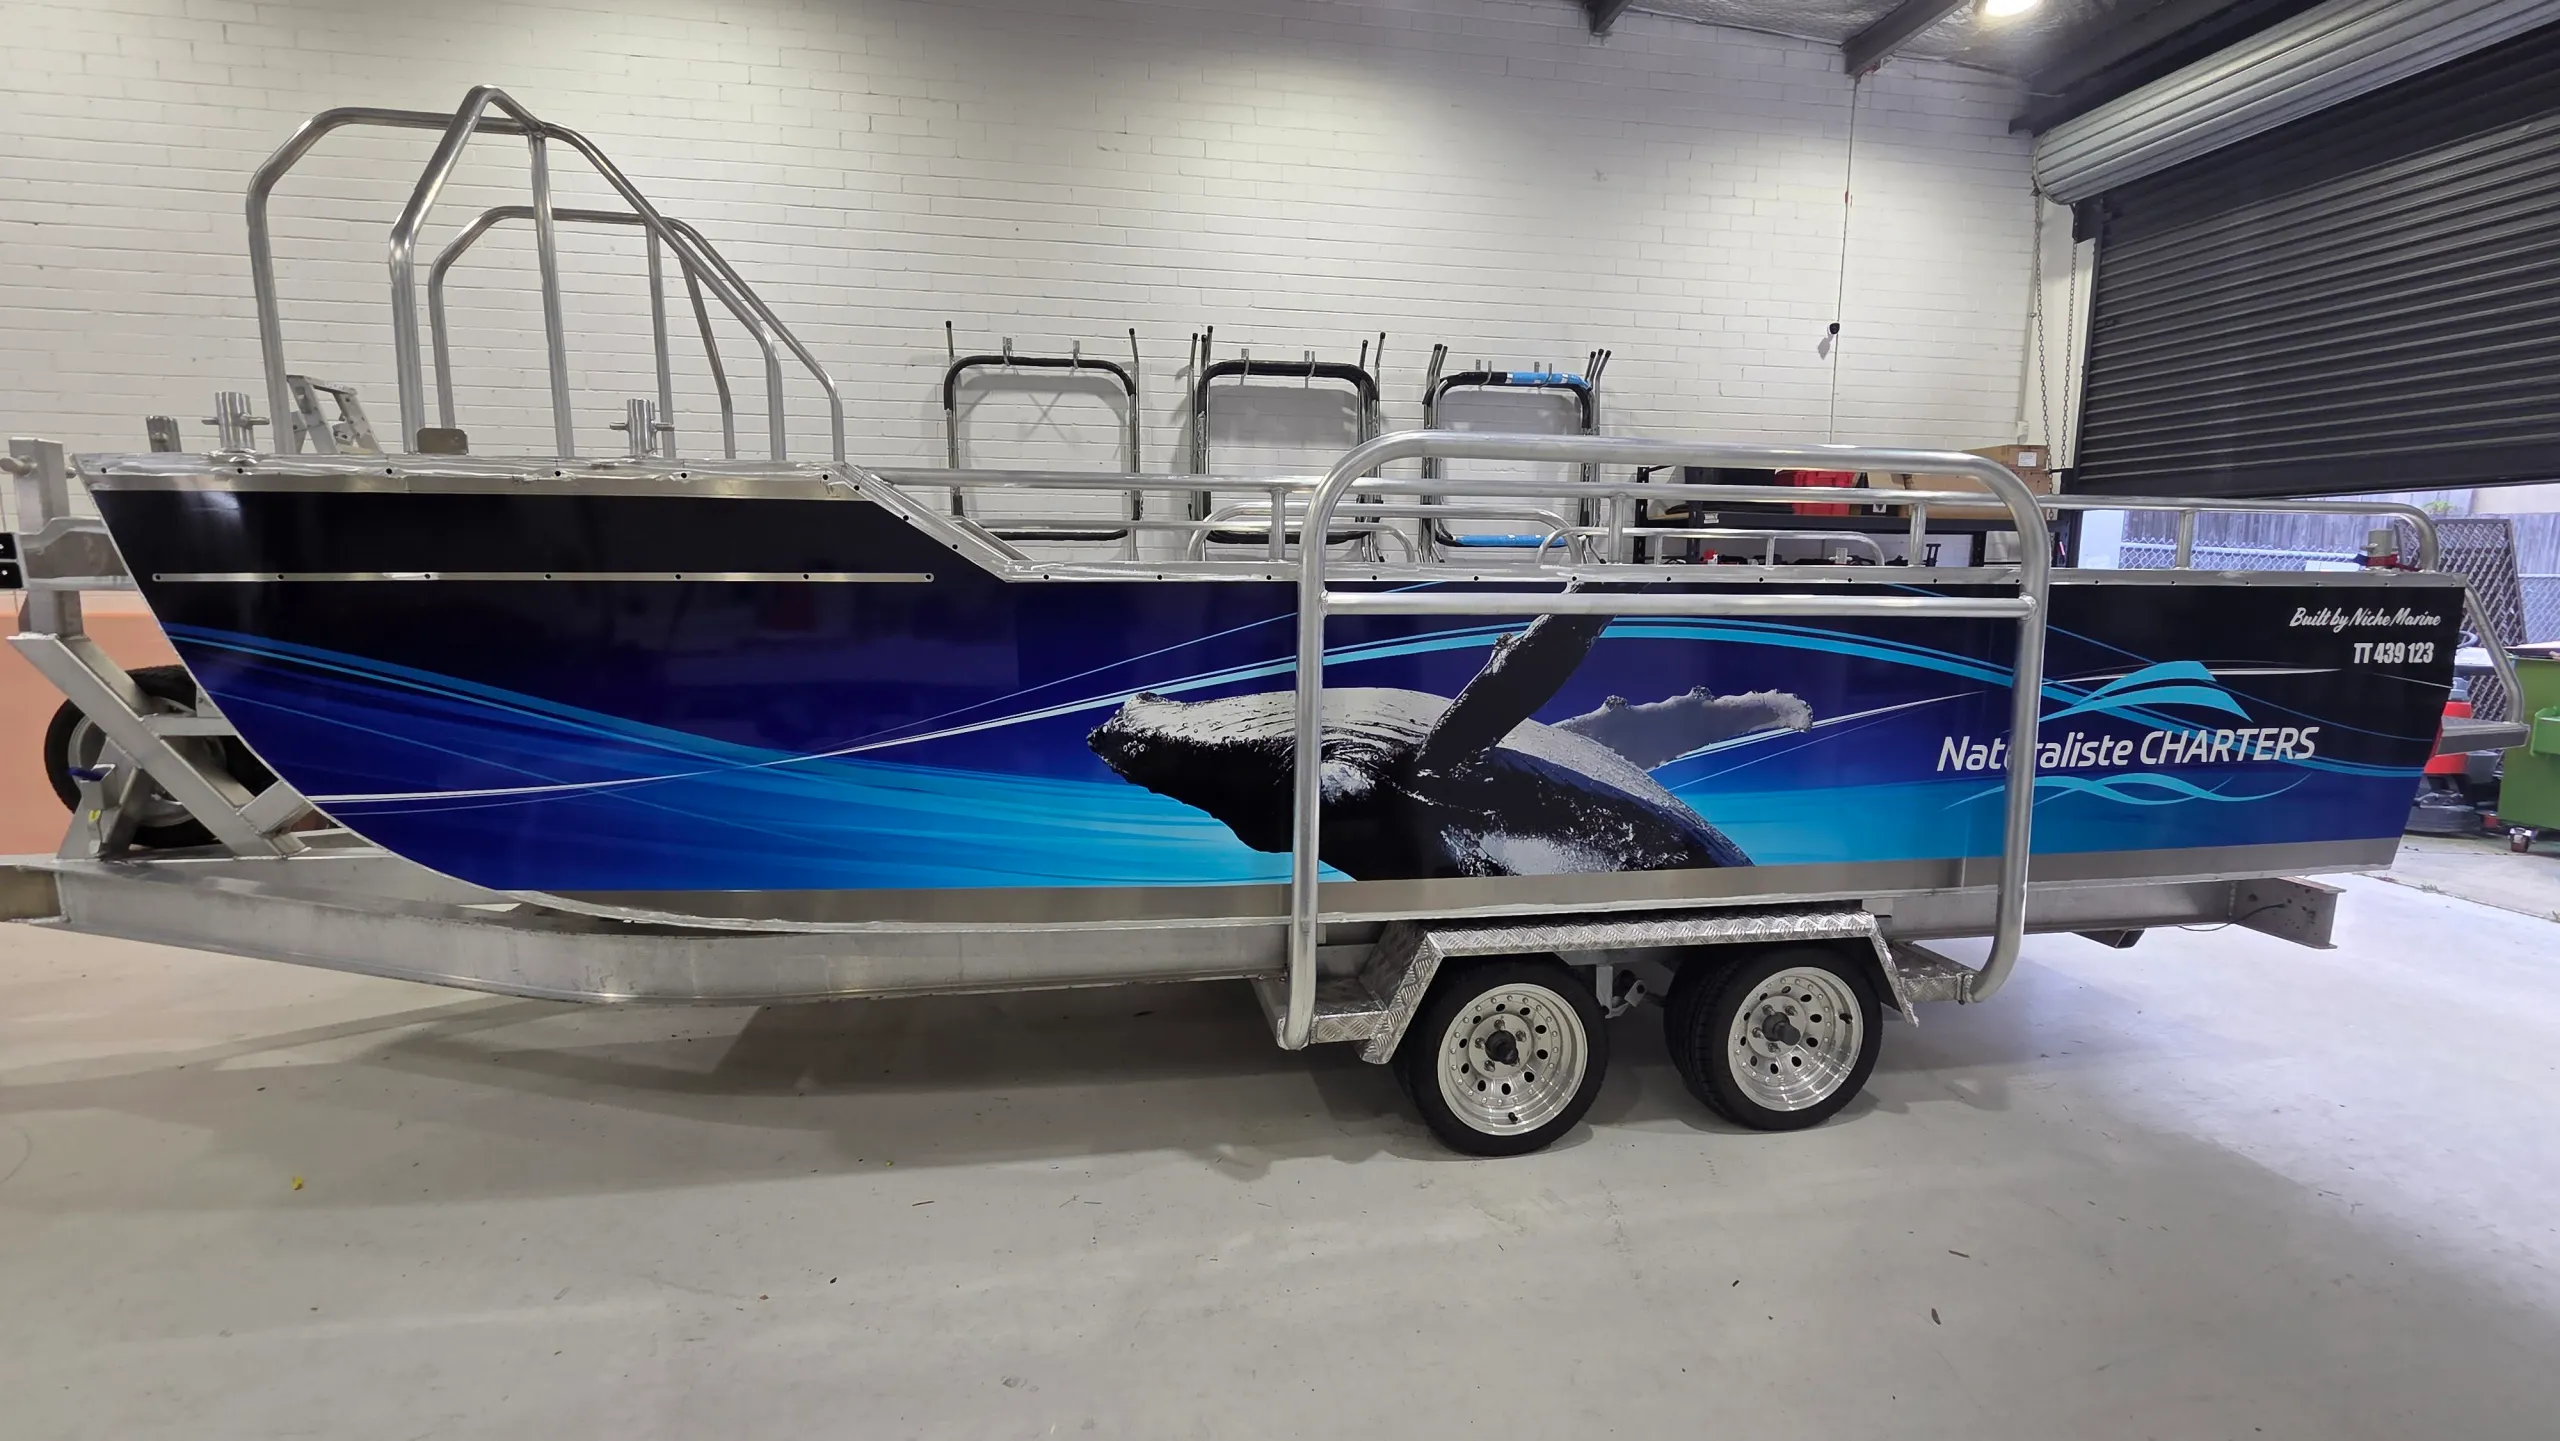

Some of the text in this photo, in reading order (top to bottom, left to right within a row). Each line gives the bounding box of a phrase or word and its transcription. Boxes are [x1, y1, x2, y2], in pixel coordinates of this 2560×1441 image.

[2289, 607, 2441, 633] Built by Niche Marine
[2353, 642, 2435, 664] TT 439 123
[1937, 726, 2320, 772] Nataliste CHARTERS
